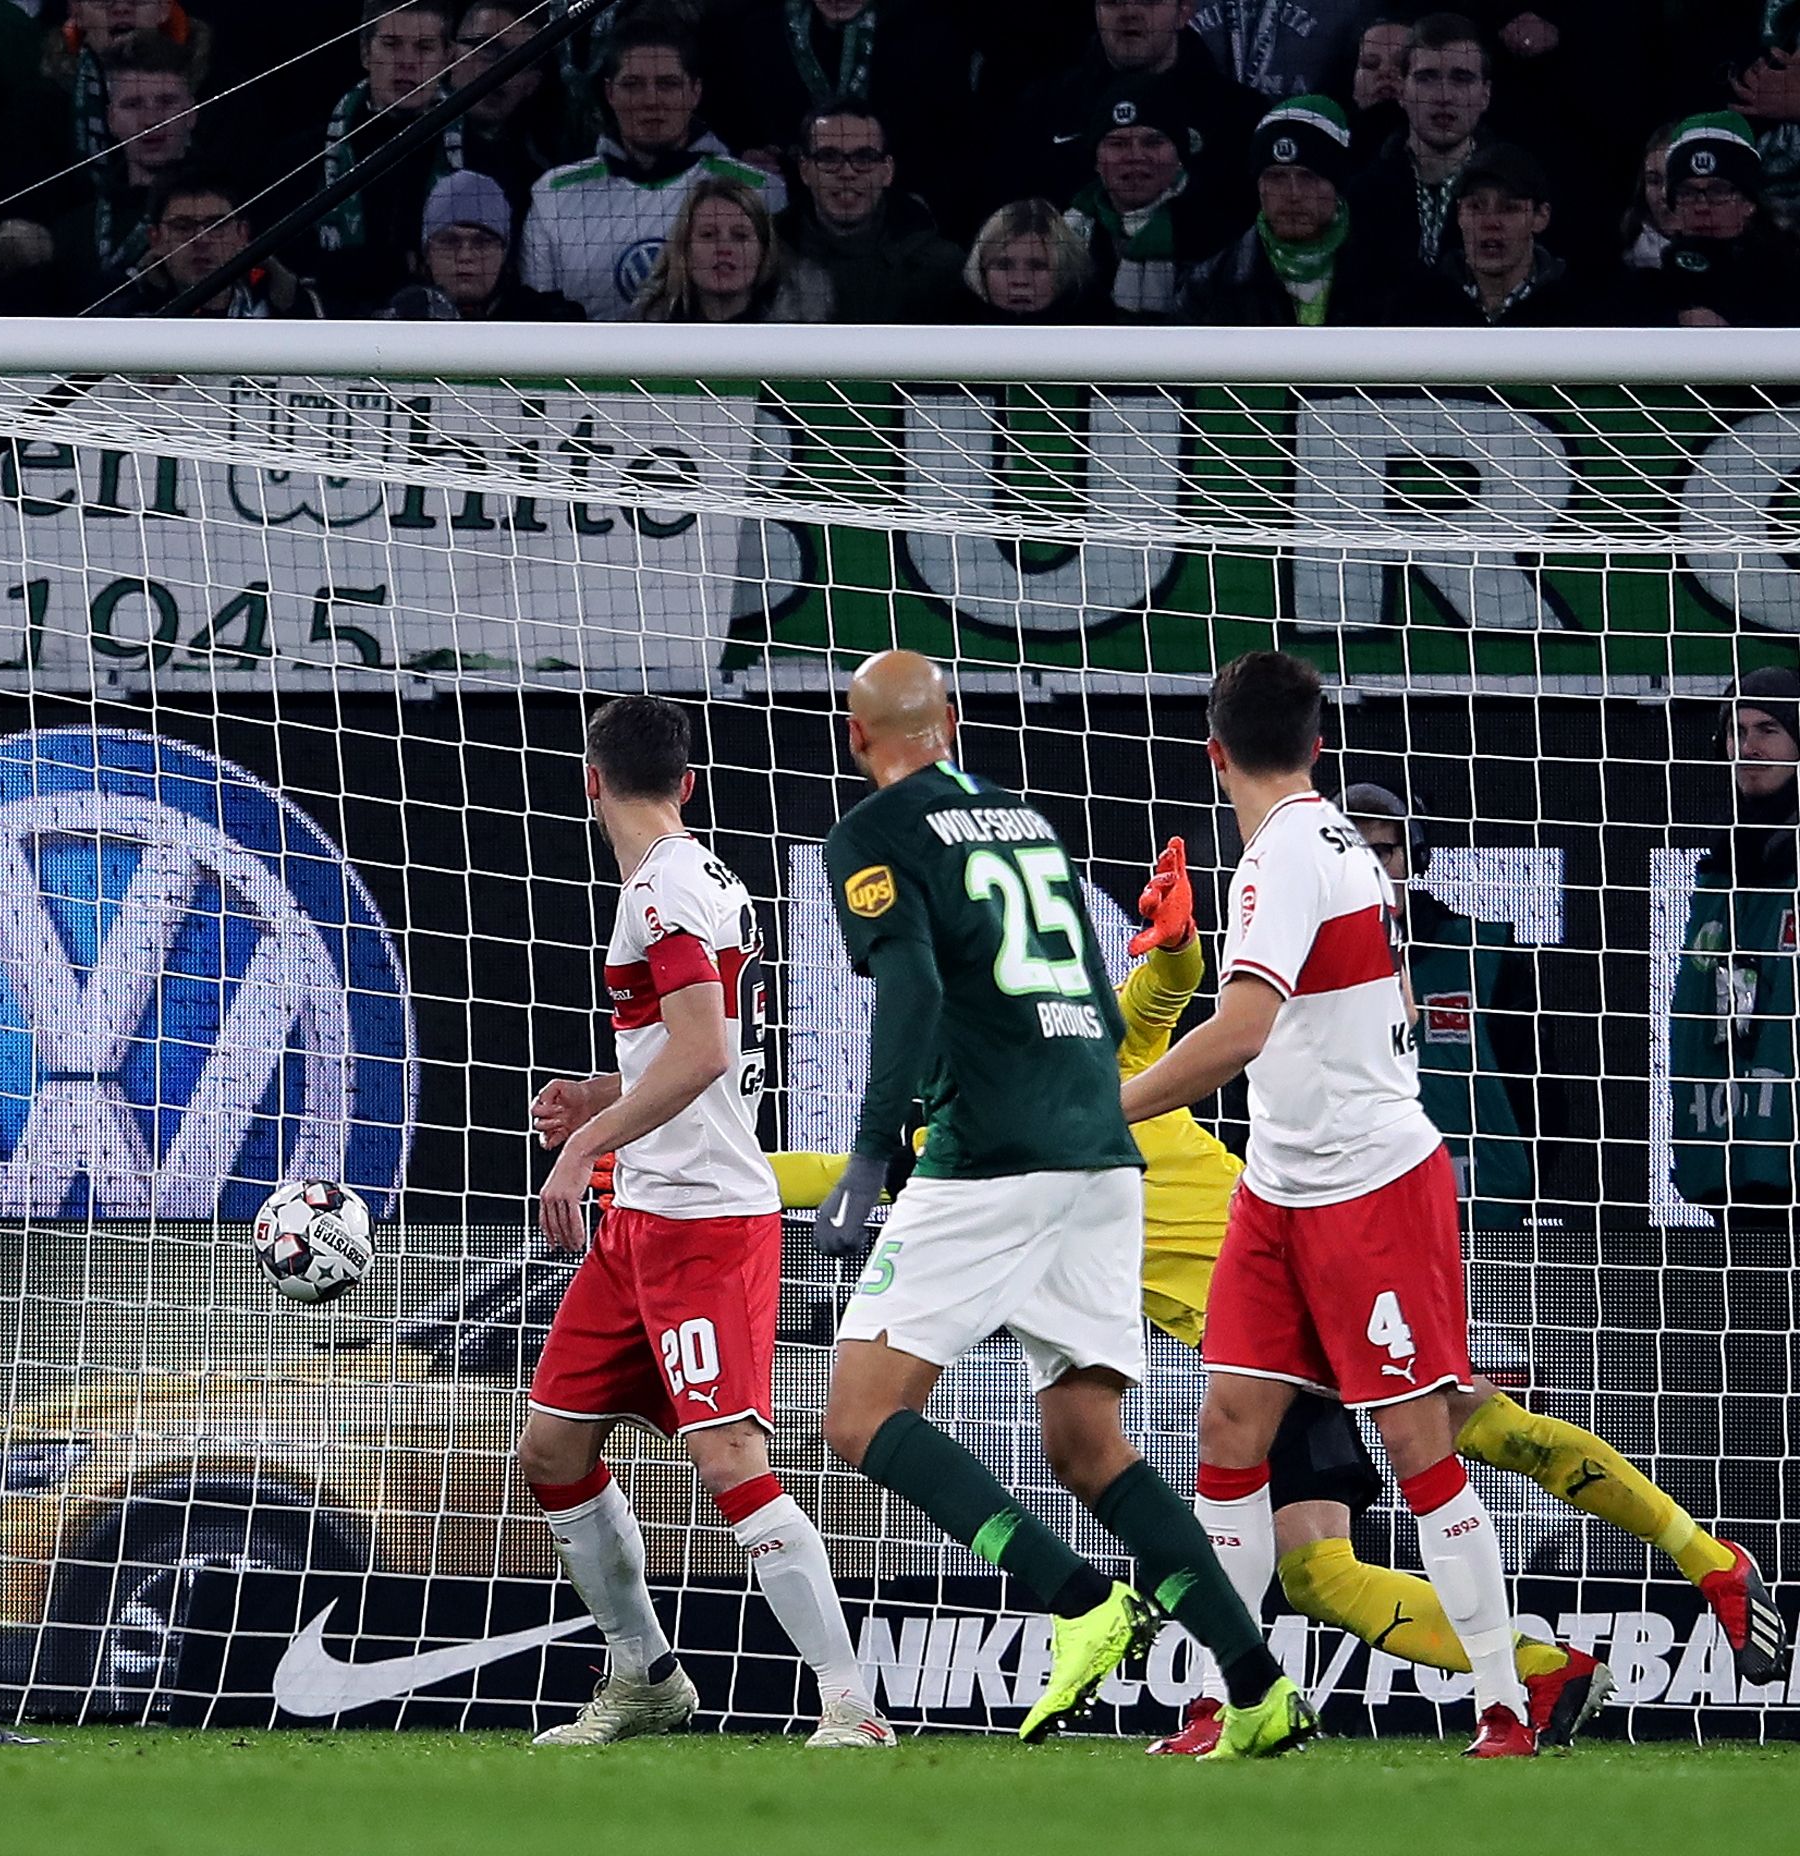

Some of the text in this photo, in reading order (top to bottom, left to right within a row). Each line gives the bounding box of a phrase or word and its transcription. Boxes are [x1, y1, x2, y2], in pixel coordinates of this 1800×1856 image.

[7, 576, 388, 670] 1945
[926, 808, 1057, 846] WOLFSBUR
[850, 880, 891, 910] ups
[964, 847, 1092, 997] 25
[854, 1240, 904, 1295] 5
[1366, 1290, 1417, 1360] 4
[661, 1317, 722, 1396] 20
[1440, 1516, 1481, 1539] 1893
